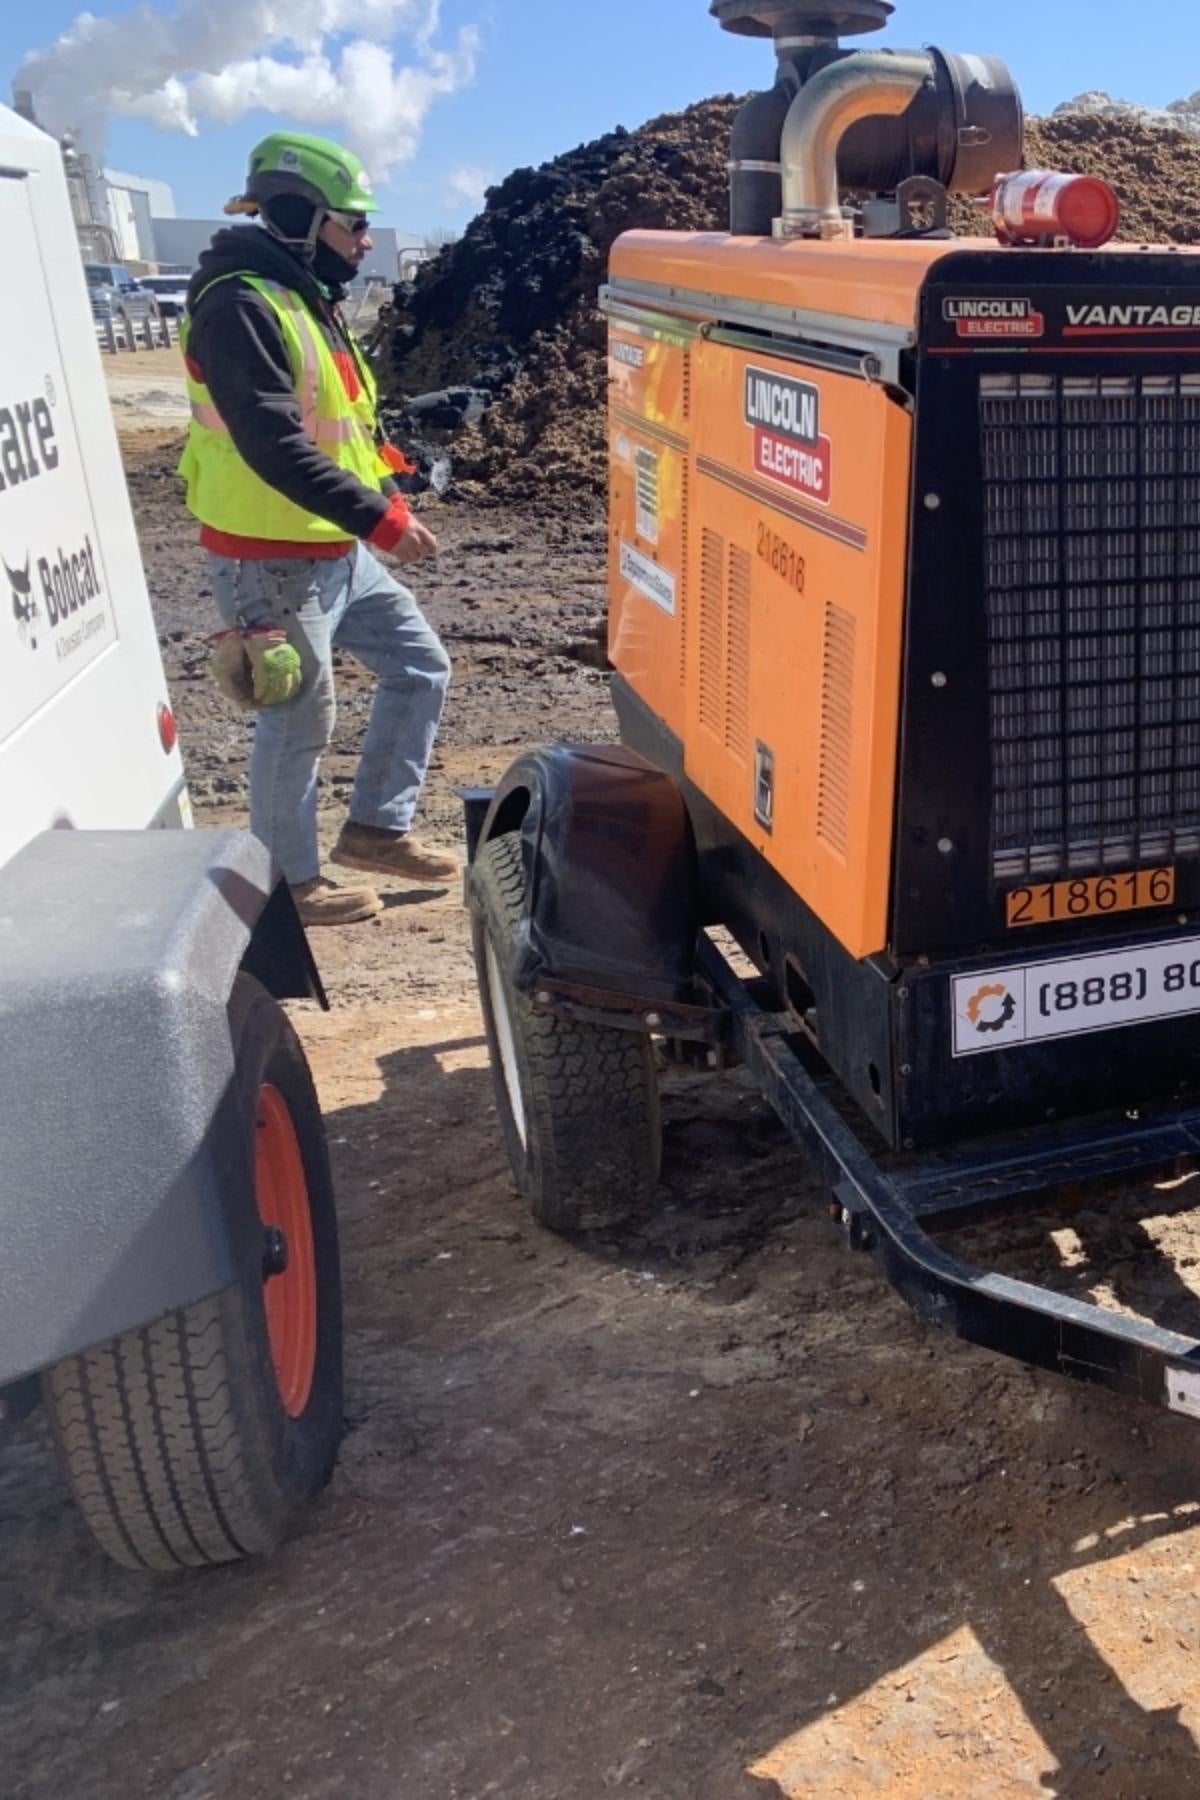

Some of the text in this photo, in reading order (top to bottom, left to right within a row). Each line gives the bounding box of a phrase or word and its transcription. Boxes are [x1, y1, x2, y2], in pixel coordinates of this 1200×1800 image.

[949, 301, 1026, 318] LINCOLN
[967, 321, 1035, 333] ELECTRIC
[747, 375, 816, 440] LINCOLN
[0, 397, 59, 492] are
[760, 436, 824, 491] ELECTRIC
[37, 534, 100, 628] Bobcat
[1010, 868, 1172, 924] 218616
[1038, 966, 1147, 1017] (888)
